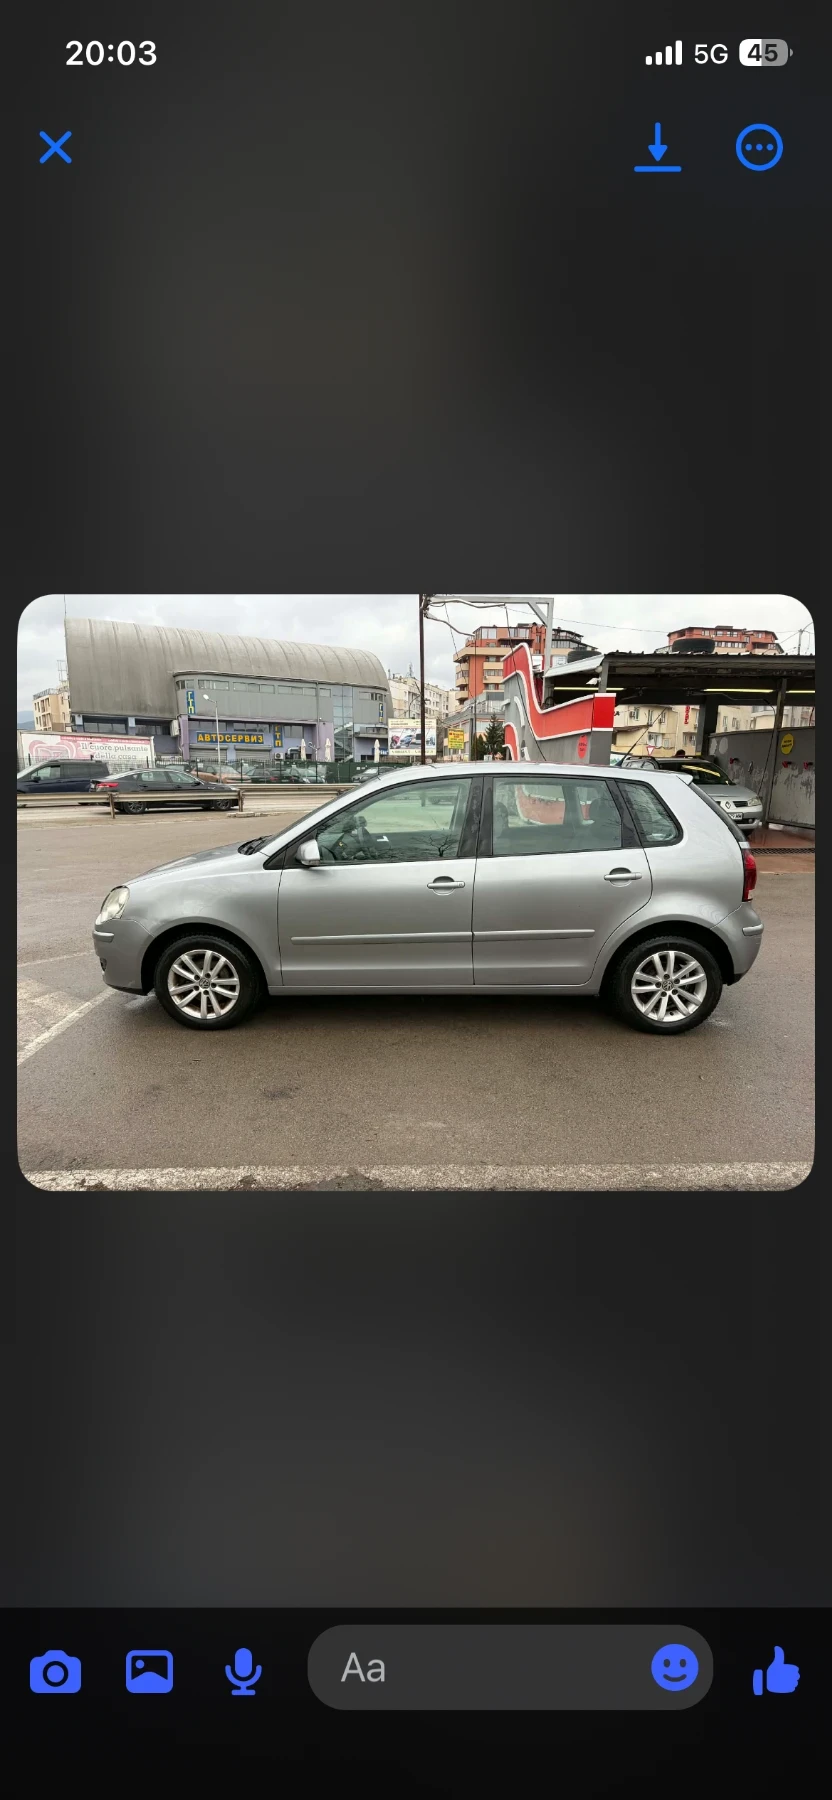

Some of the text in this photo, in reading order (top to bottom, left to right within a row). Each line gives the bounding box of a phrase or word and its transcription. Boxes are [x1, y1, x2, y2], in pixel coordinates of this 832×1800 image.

[187, 691, 195, 714] ГТП
[197, 733, 264, 743] АВТОСЕРВИЗ
[81, 742, 88, 750] Il
[89, 743, 113, 752] cuore
[94, 751, 117, 760] della
